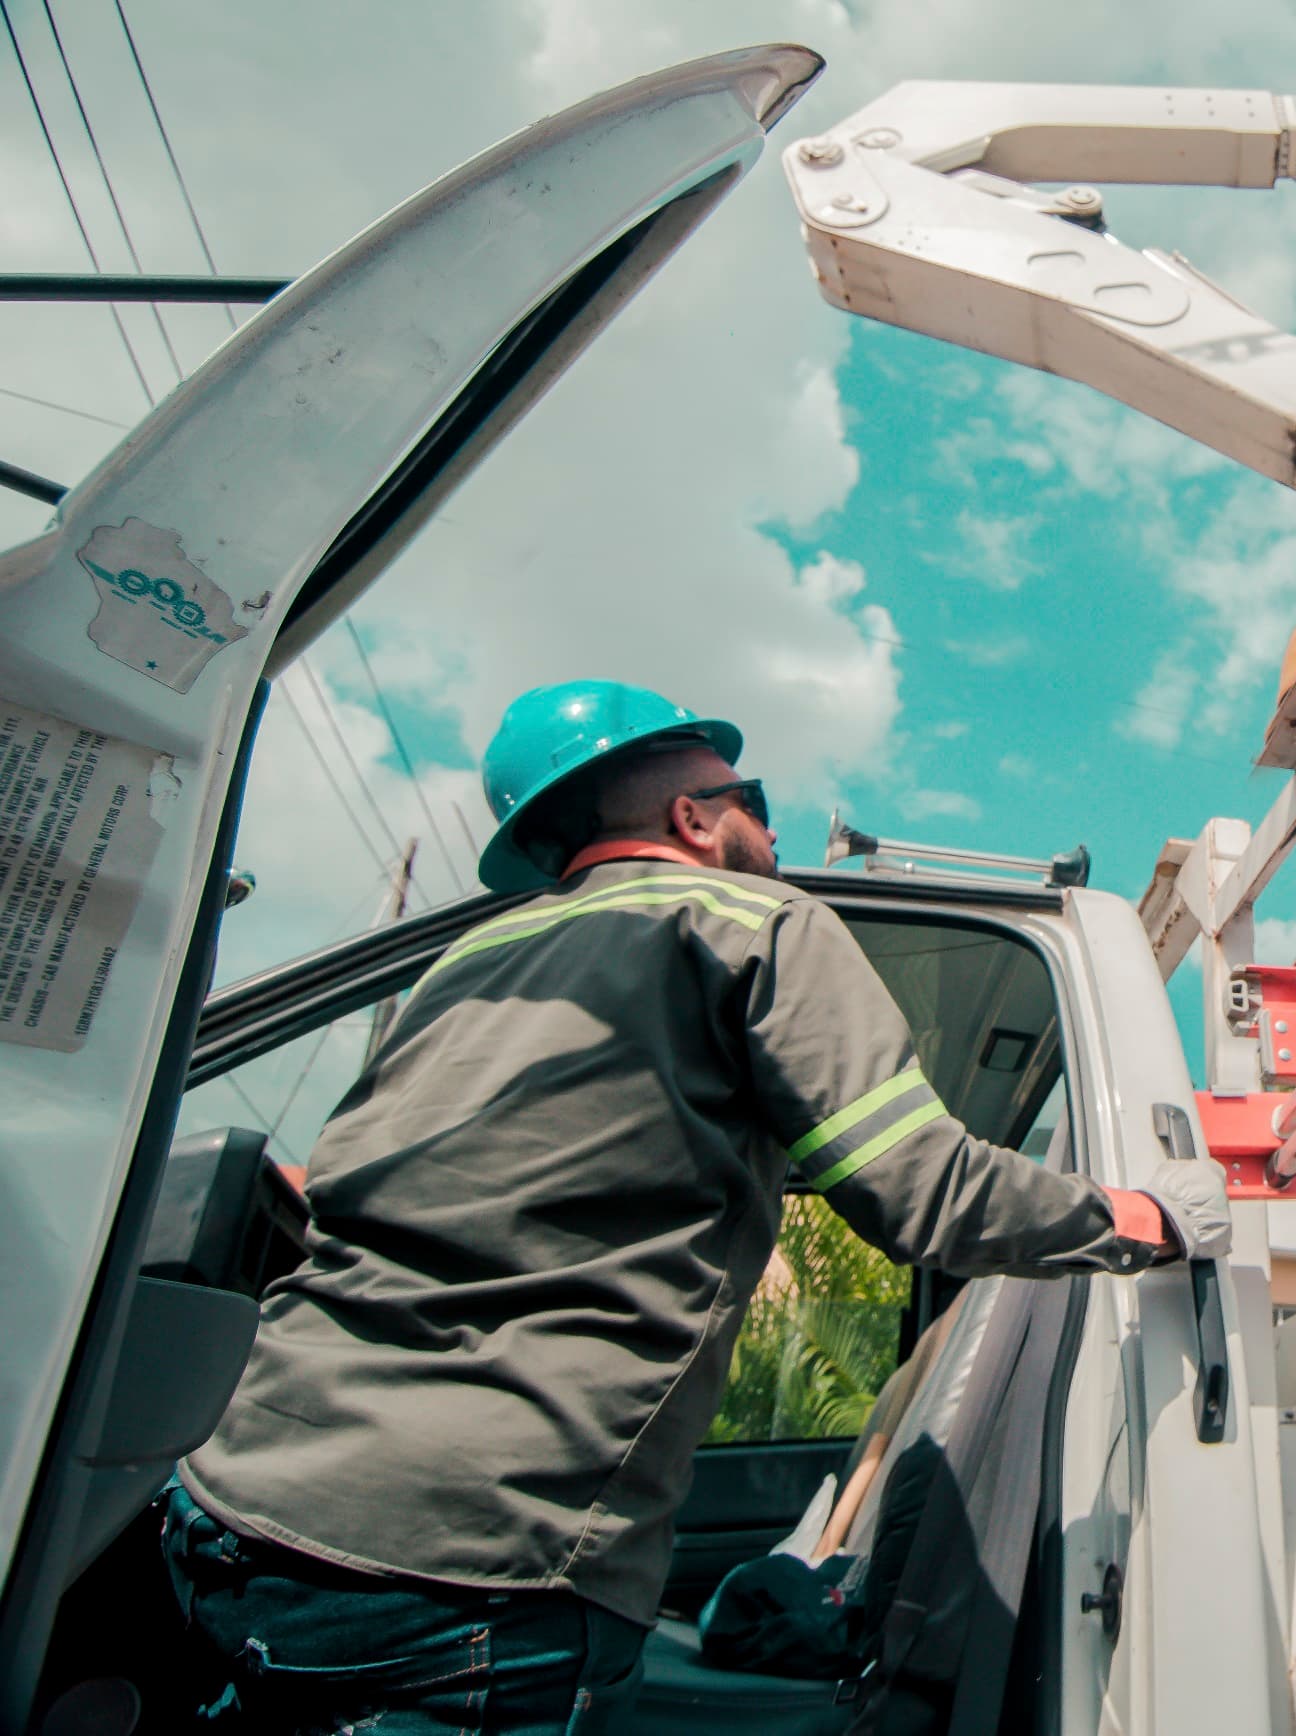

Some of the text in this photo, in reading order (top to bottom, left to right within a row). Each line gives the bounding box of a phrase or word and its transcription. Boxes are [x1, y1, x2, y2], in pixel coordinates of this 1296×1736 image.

[0, 893, 22, 924] OTHER
[14, 860, 36, 893] SAFETY
[28, 810, 57, 859] STANDARDS
[49, 763, 76, 809] APPLICABLE
[74, 729, 90, 749] THIS
[5, 765, 34, 814] INCOMPLETE
[26, 730, 48, 764] VEHICLE
[23, 794, 39, 815] PART
[0, 952, 15, 980] WHEN
[8, 899, 38, 951] COMPLETED
[43, 803, 78, 868] SUBSTANTIALLY
[70, 763, 94, 803] AFFECTED
[48, 892, 87, 962] MANUFACTURED
[83, 842, 108, 878] GENERAL
[98, 807, 119, 840] MOTORS
[6, 969, 28, 1003] DESIGN
[34, 898, 58, 936] CHASSIS
